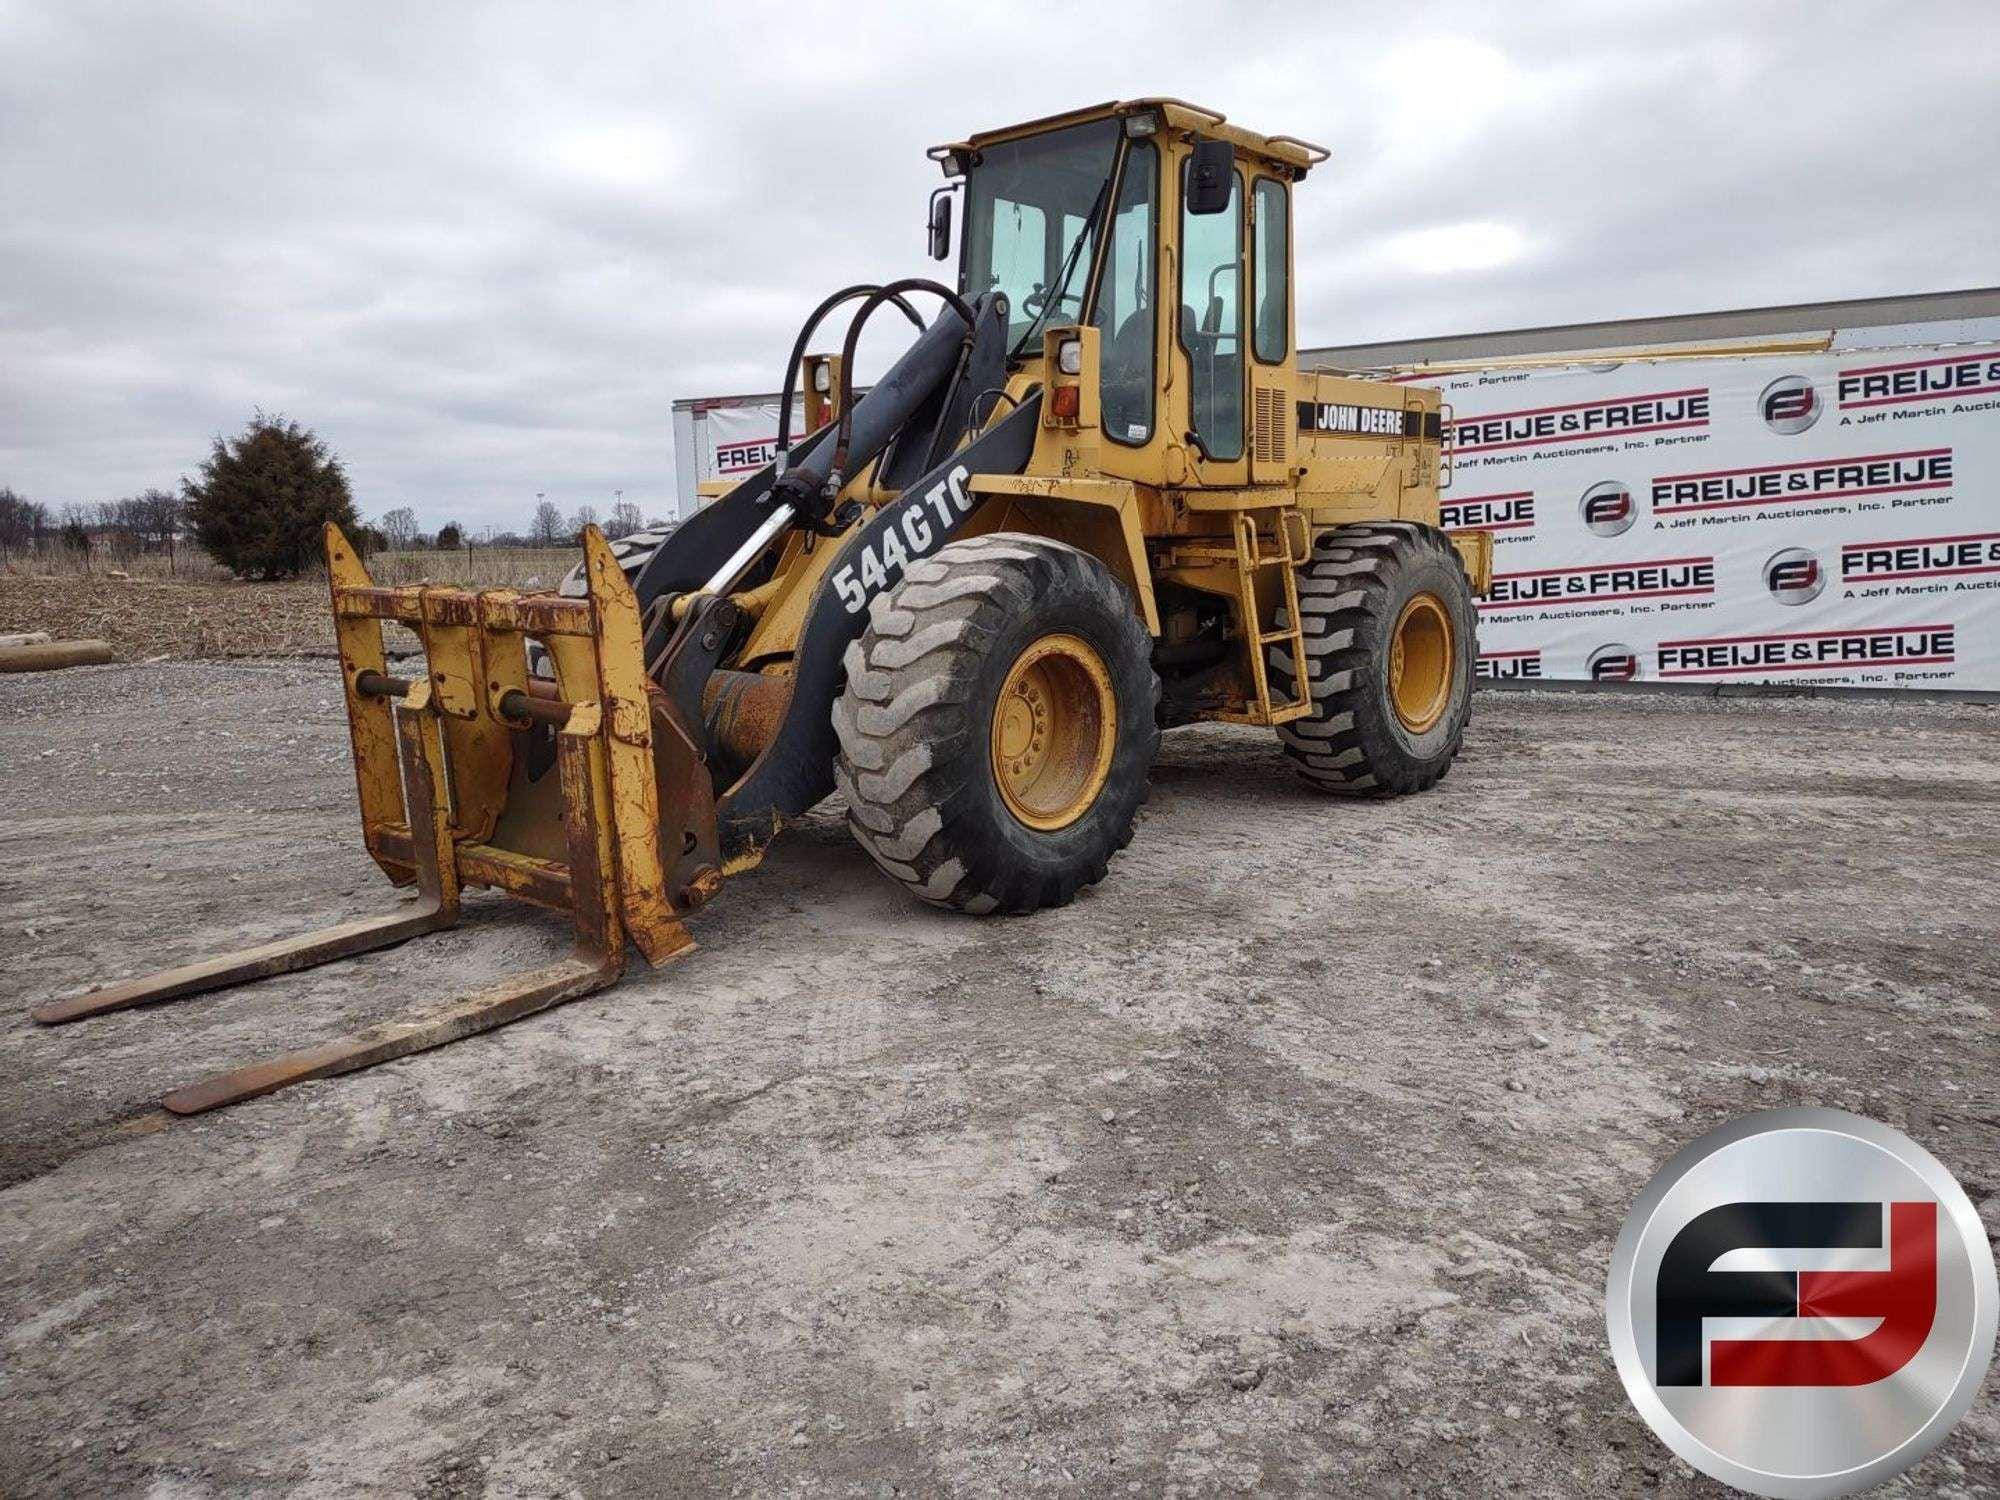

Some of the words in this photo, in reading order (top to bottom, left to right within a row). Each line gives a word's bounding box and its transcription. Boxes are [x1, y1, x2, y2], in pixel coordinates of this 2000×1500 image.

[1451, 382, 1473, 390] Inc.
[1479, 373, 1530, 386] Partner
[1839, 362, 1981, 401] FREIJE
[1318, 404, 1358, 432] JOHN
[1360, 407, 1403, 435] DEERE
[1584, 396, 1709, 431] FREIJE
[1840, 417, 1852, 426] A
[1857, 413, 1887, 425] Jeff
[1893, 406, 1946, 420] Martin
[1454, 459, 1478, 470] Jeff
[1483, 455, 1528, 466] Martin
[1533, 445, 1619, 461] Auctioneers,
[1625, 440, 1649, 449] Inc.
[1655, 434, 1710, 447] Partner
[1652, 473, 1782, 507] FREIJE
[1813, 457, 1953, 491] FREIJE
[1440, 499, 1535, 528] REIJE
[1654, 522, 1665, 530] A
[1670, 518, 1697, 529] Jeff
[1702, 513, 1750, 526] Martin
[1756, 506, 1852, 521] Auctioneers,
[1858, 502, 1885, 512] Inc.
[1891, 496, 1953, 509] Partner
[1494, 535, 1536, 544] artner
[1842, 543, 1982, 575] FREIJE
[1480, 577, 1562, 602] EIJE
[1590, 564, 1715, 594] FREIJE
[1844, 590, 1856, 599] A
[1860, 586, 1890, 598] Jeff
[1895, 583, 1949, 596] Martin
[1490, 613, 1534, 624] Martin
[1539, 607, 1624, 621] Auctioneers,
[1631, 605, 1655, 614] Inc.
[1661, 600, 1716, 612] Partner
[1658, 642, 1786, 670] FREIJE
[1817, 632, 1955, 662] FREIJE
[1476, 658, 1541, 679] EIJE
[1861, 673, 1888, 683] Inc.
[1894, 670, 1956, 682] Partner
